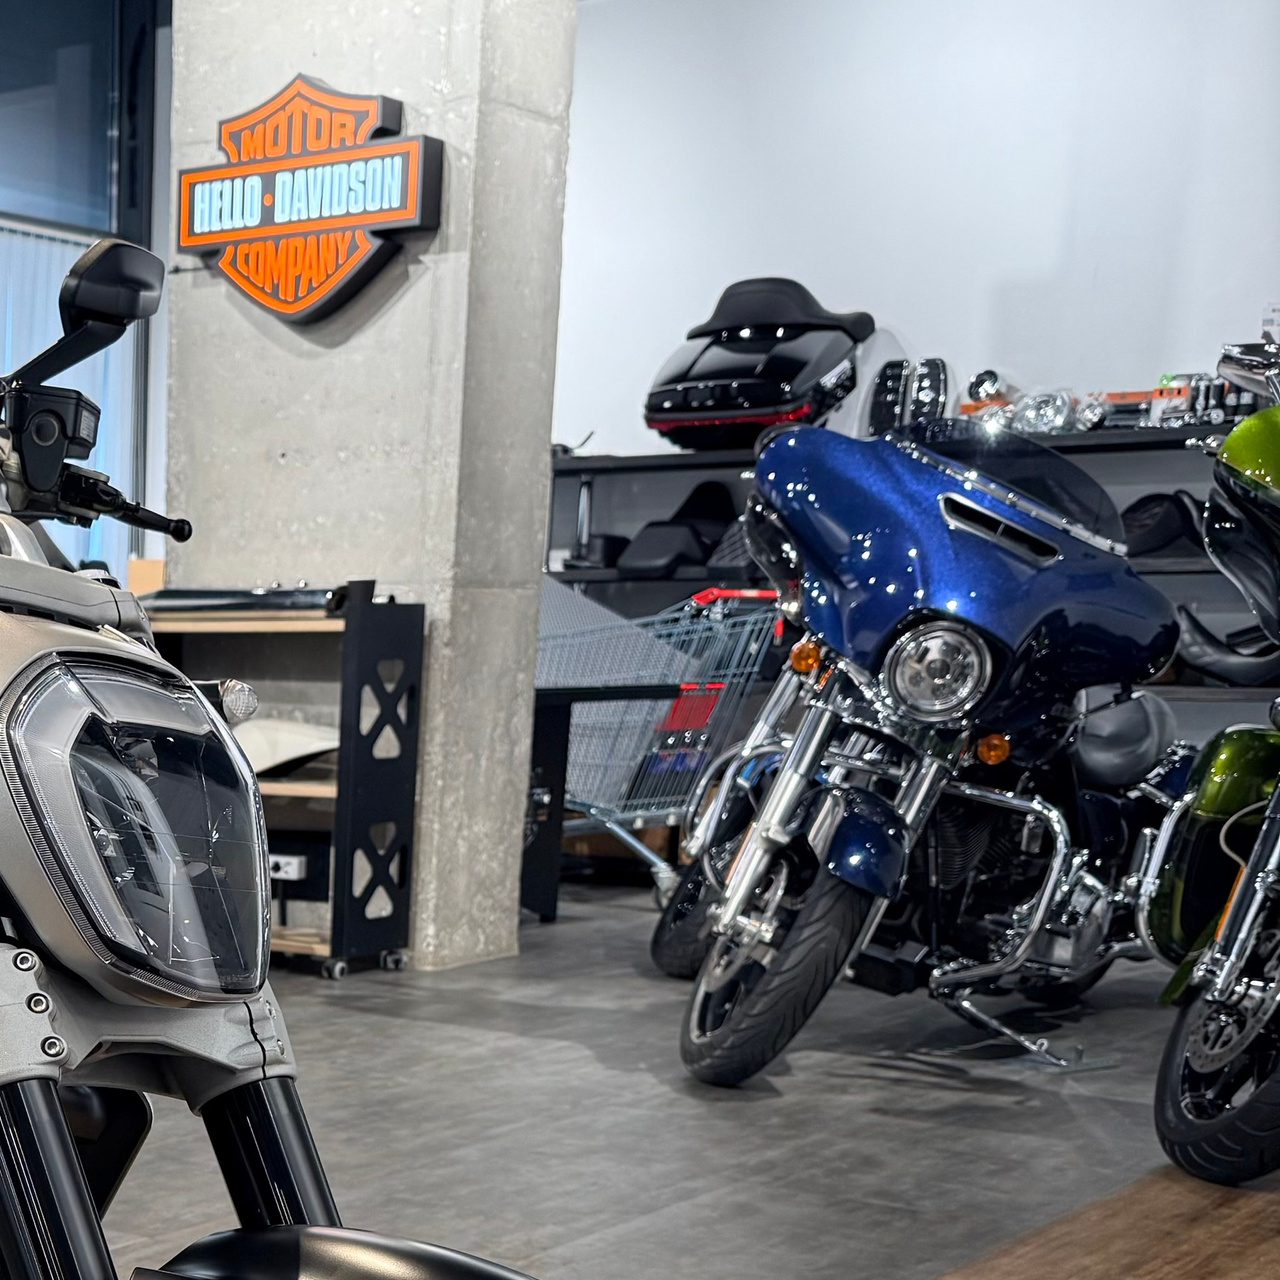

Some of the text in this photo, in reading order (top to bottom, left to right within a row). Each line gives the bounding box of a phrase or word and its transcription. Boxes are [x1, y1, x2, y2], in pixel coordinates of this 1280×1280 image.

[240, 96, 356, 162] MOTOR
[193, 155, 403, 234] HELLO DAVIDSON
[236, 230, 353, 301] COMPANY
